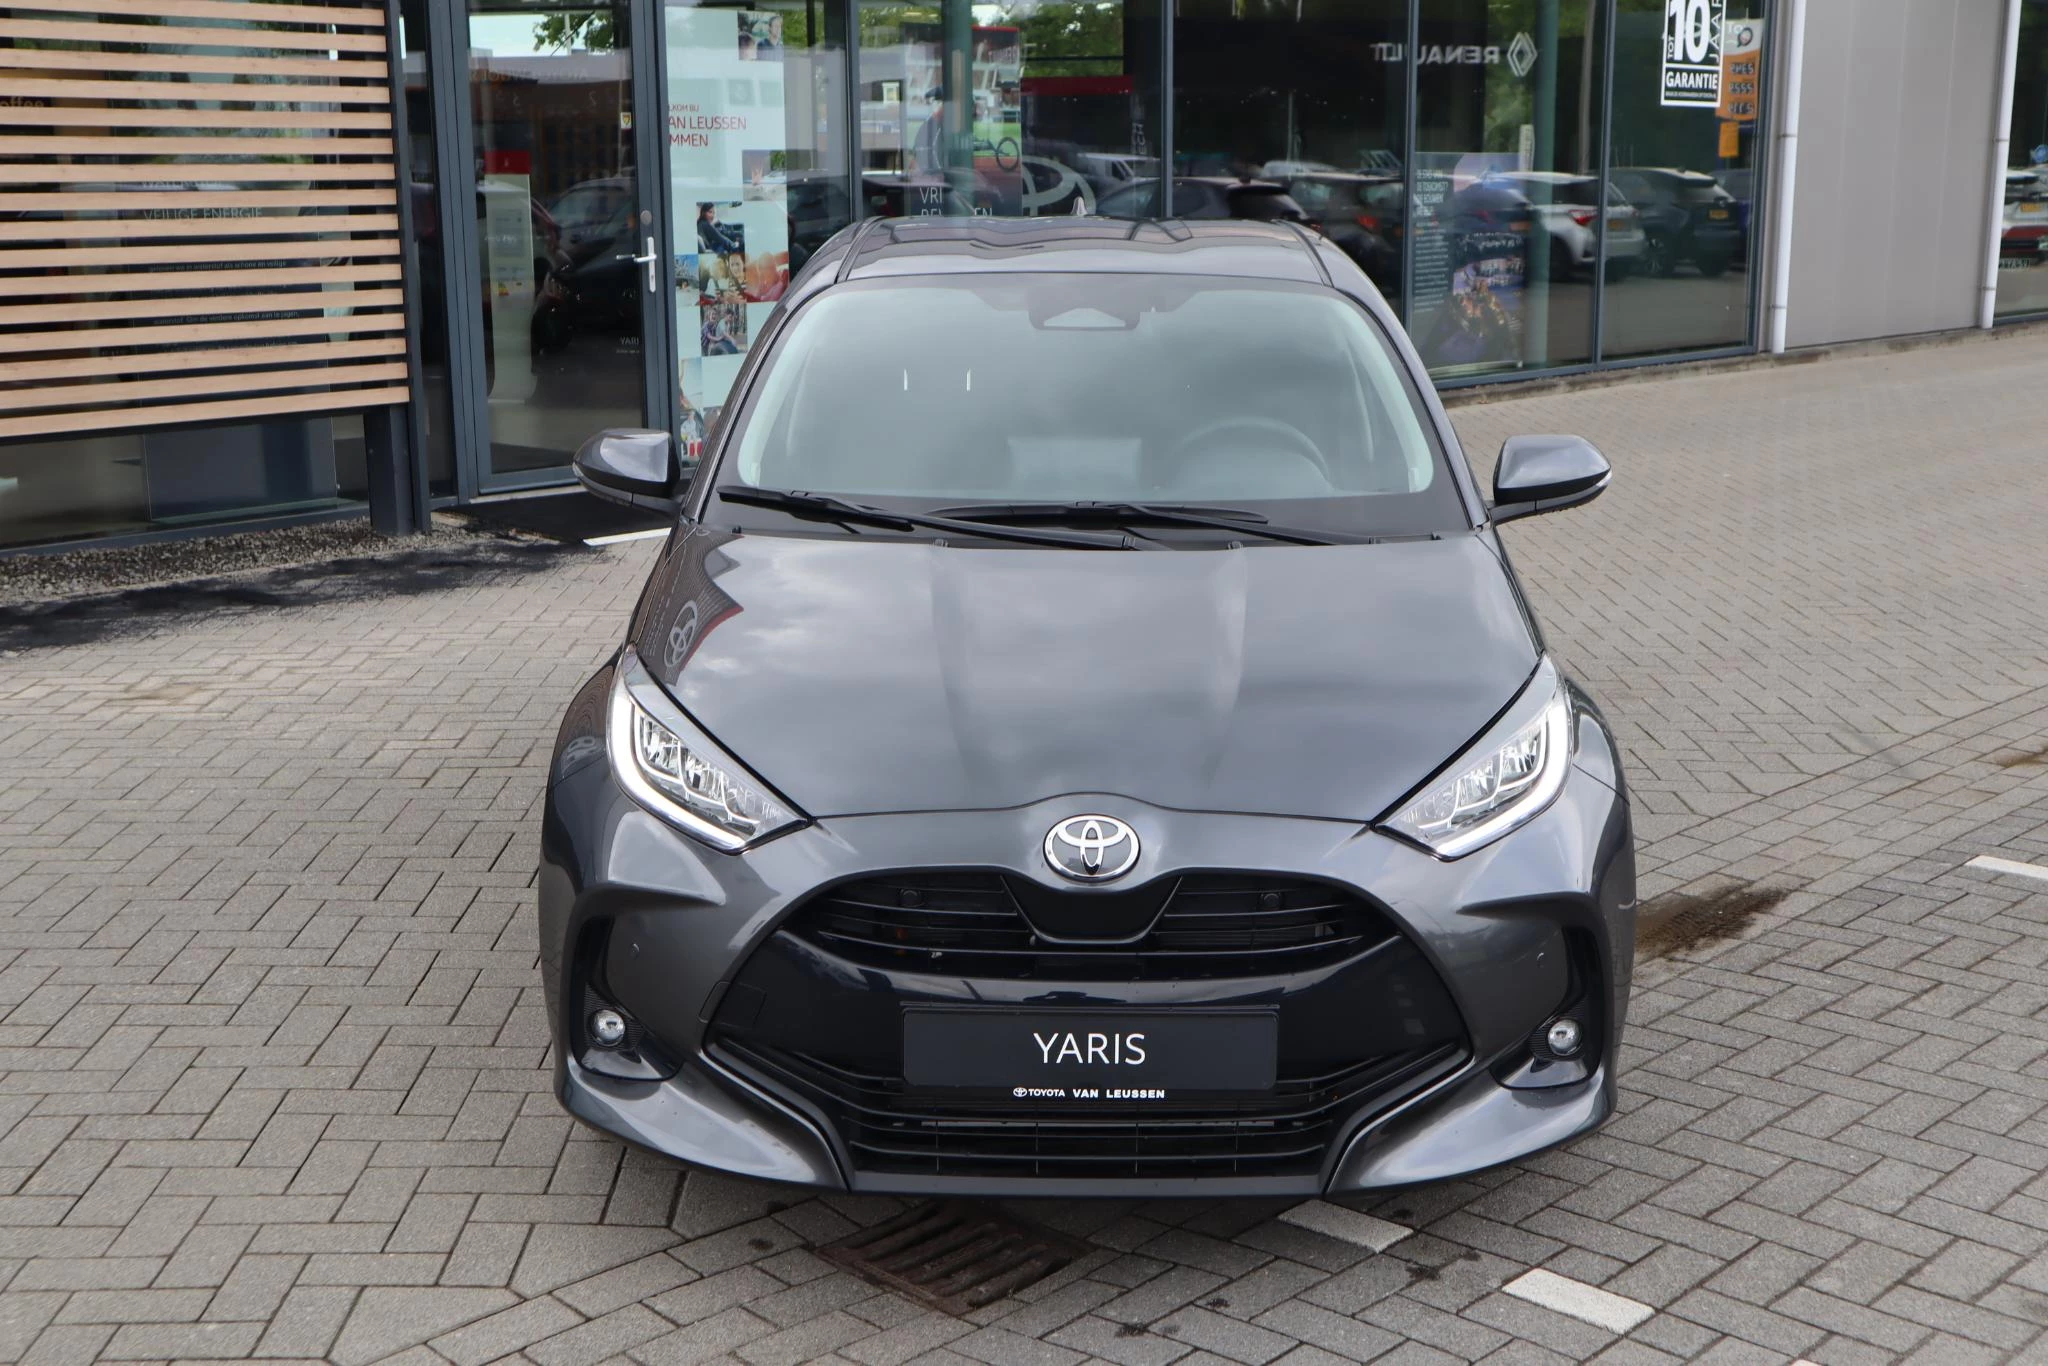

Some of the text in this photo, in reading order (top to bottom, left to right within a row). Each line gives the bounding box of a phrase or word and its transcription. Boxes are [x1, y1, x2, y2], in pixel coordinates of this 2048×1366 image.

[1669, 0, 1710, 62] 10
[1666, 71, 1718, 90] GARANTIE
[690, 116, 746, 129] LEUSSEN
[1033, 1032, 1146, 1065] YARIS
[1028, 1088, 1165, 1098] TOYOTA VAN LEUSSEN
